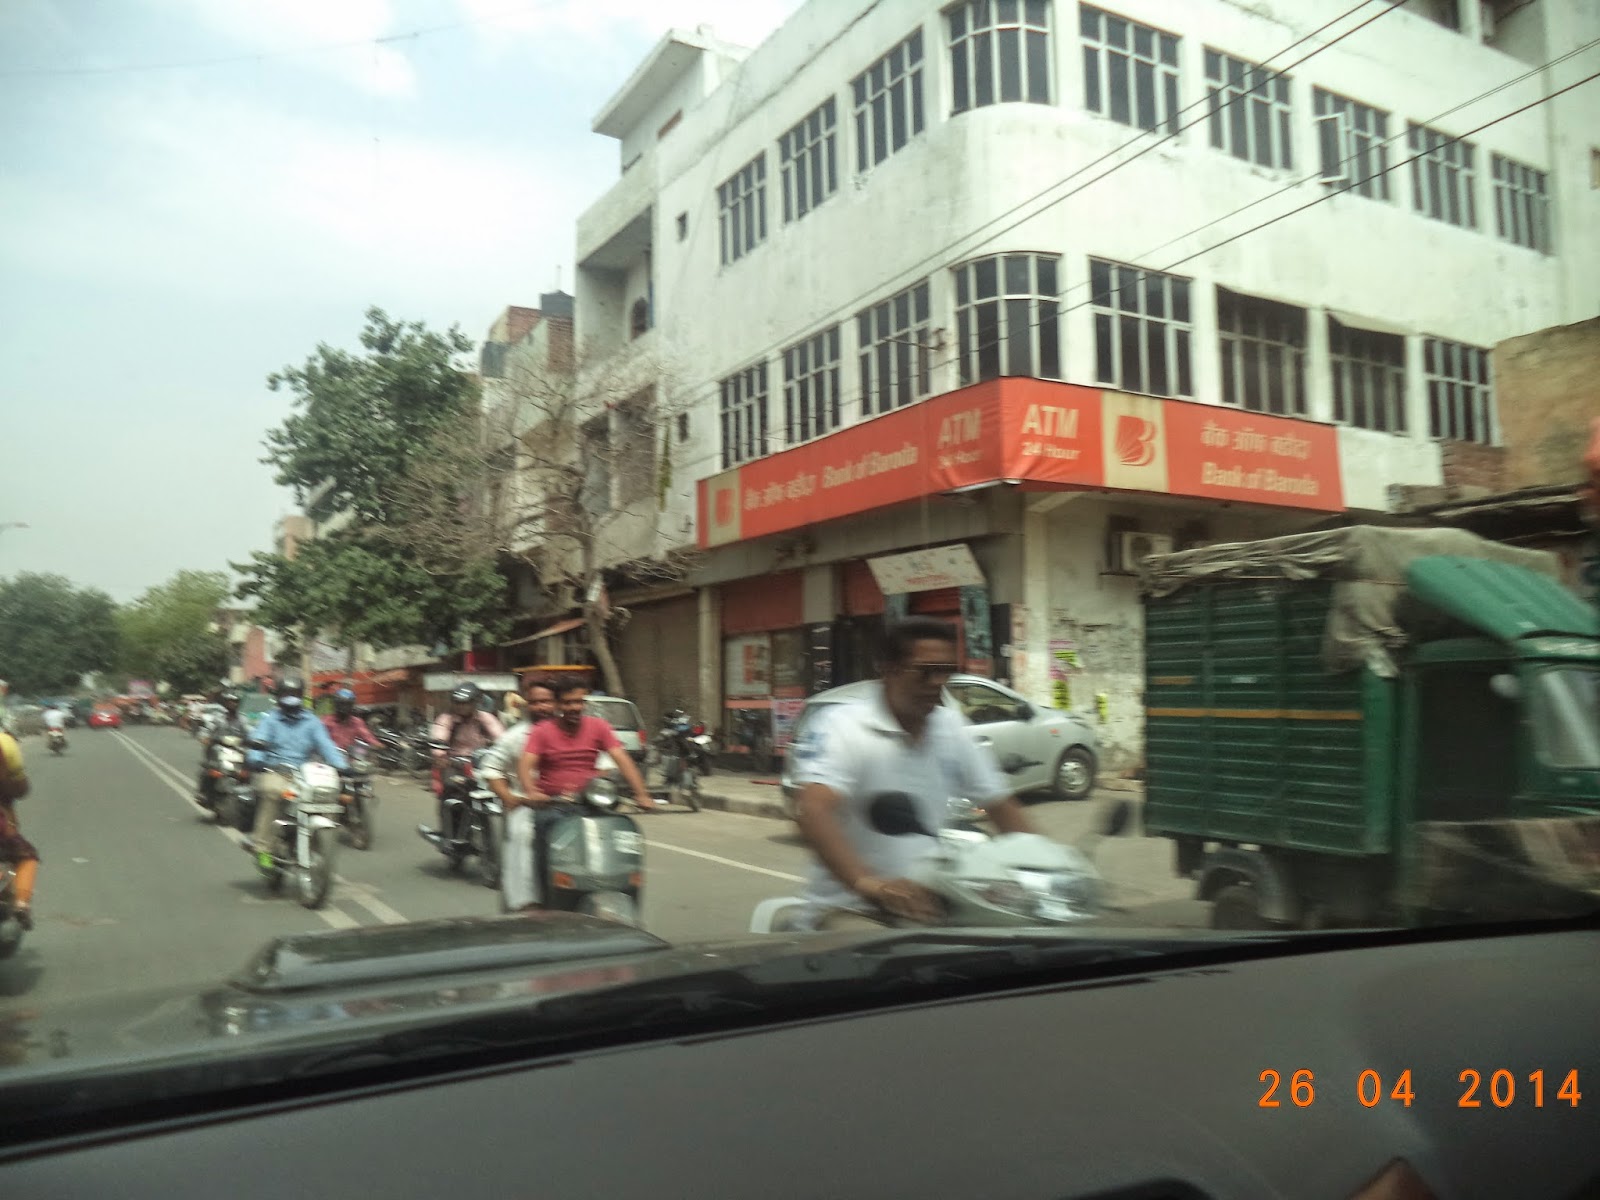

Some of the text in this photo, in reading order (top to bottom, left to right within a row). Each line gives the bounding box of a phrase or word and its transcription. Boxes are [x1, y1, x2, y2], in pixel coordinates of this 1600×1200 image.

[936, 407, 982, 450] ATM
[1021, 404, 1080, 439] ATM
[822, 460, 854, 489] Bank
[1201, 462, 1243, 488] Bank
[1263, 469, 1320, 496] Baroda
